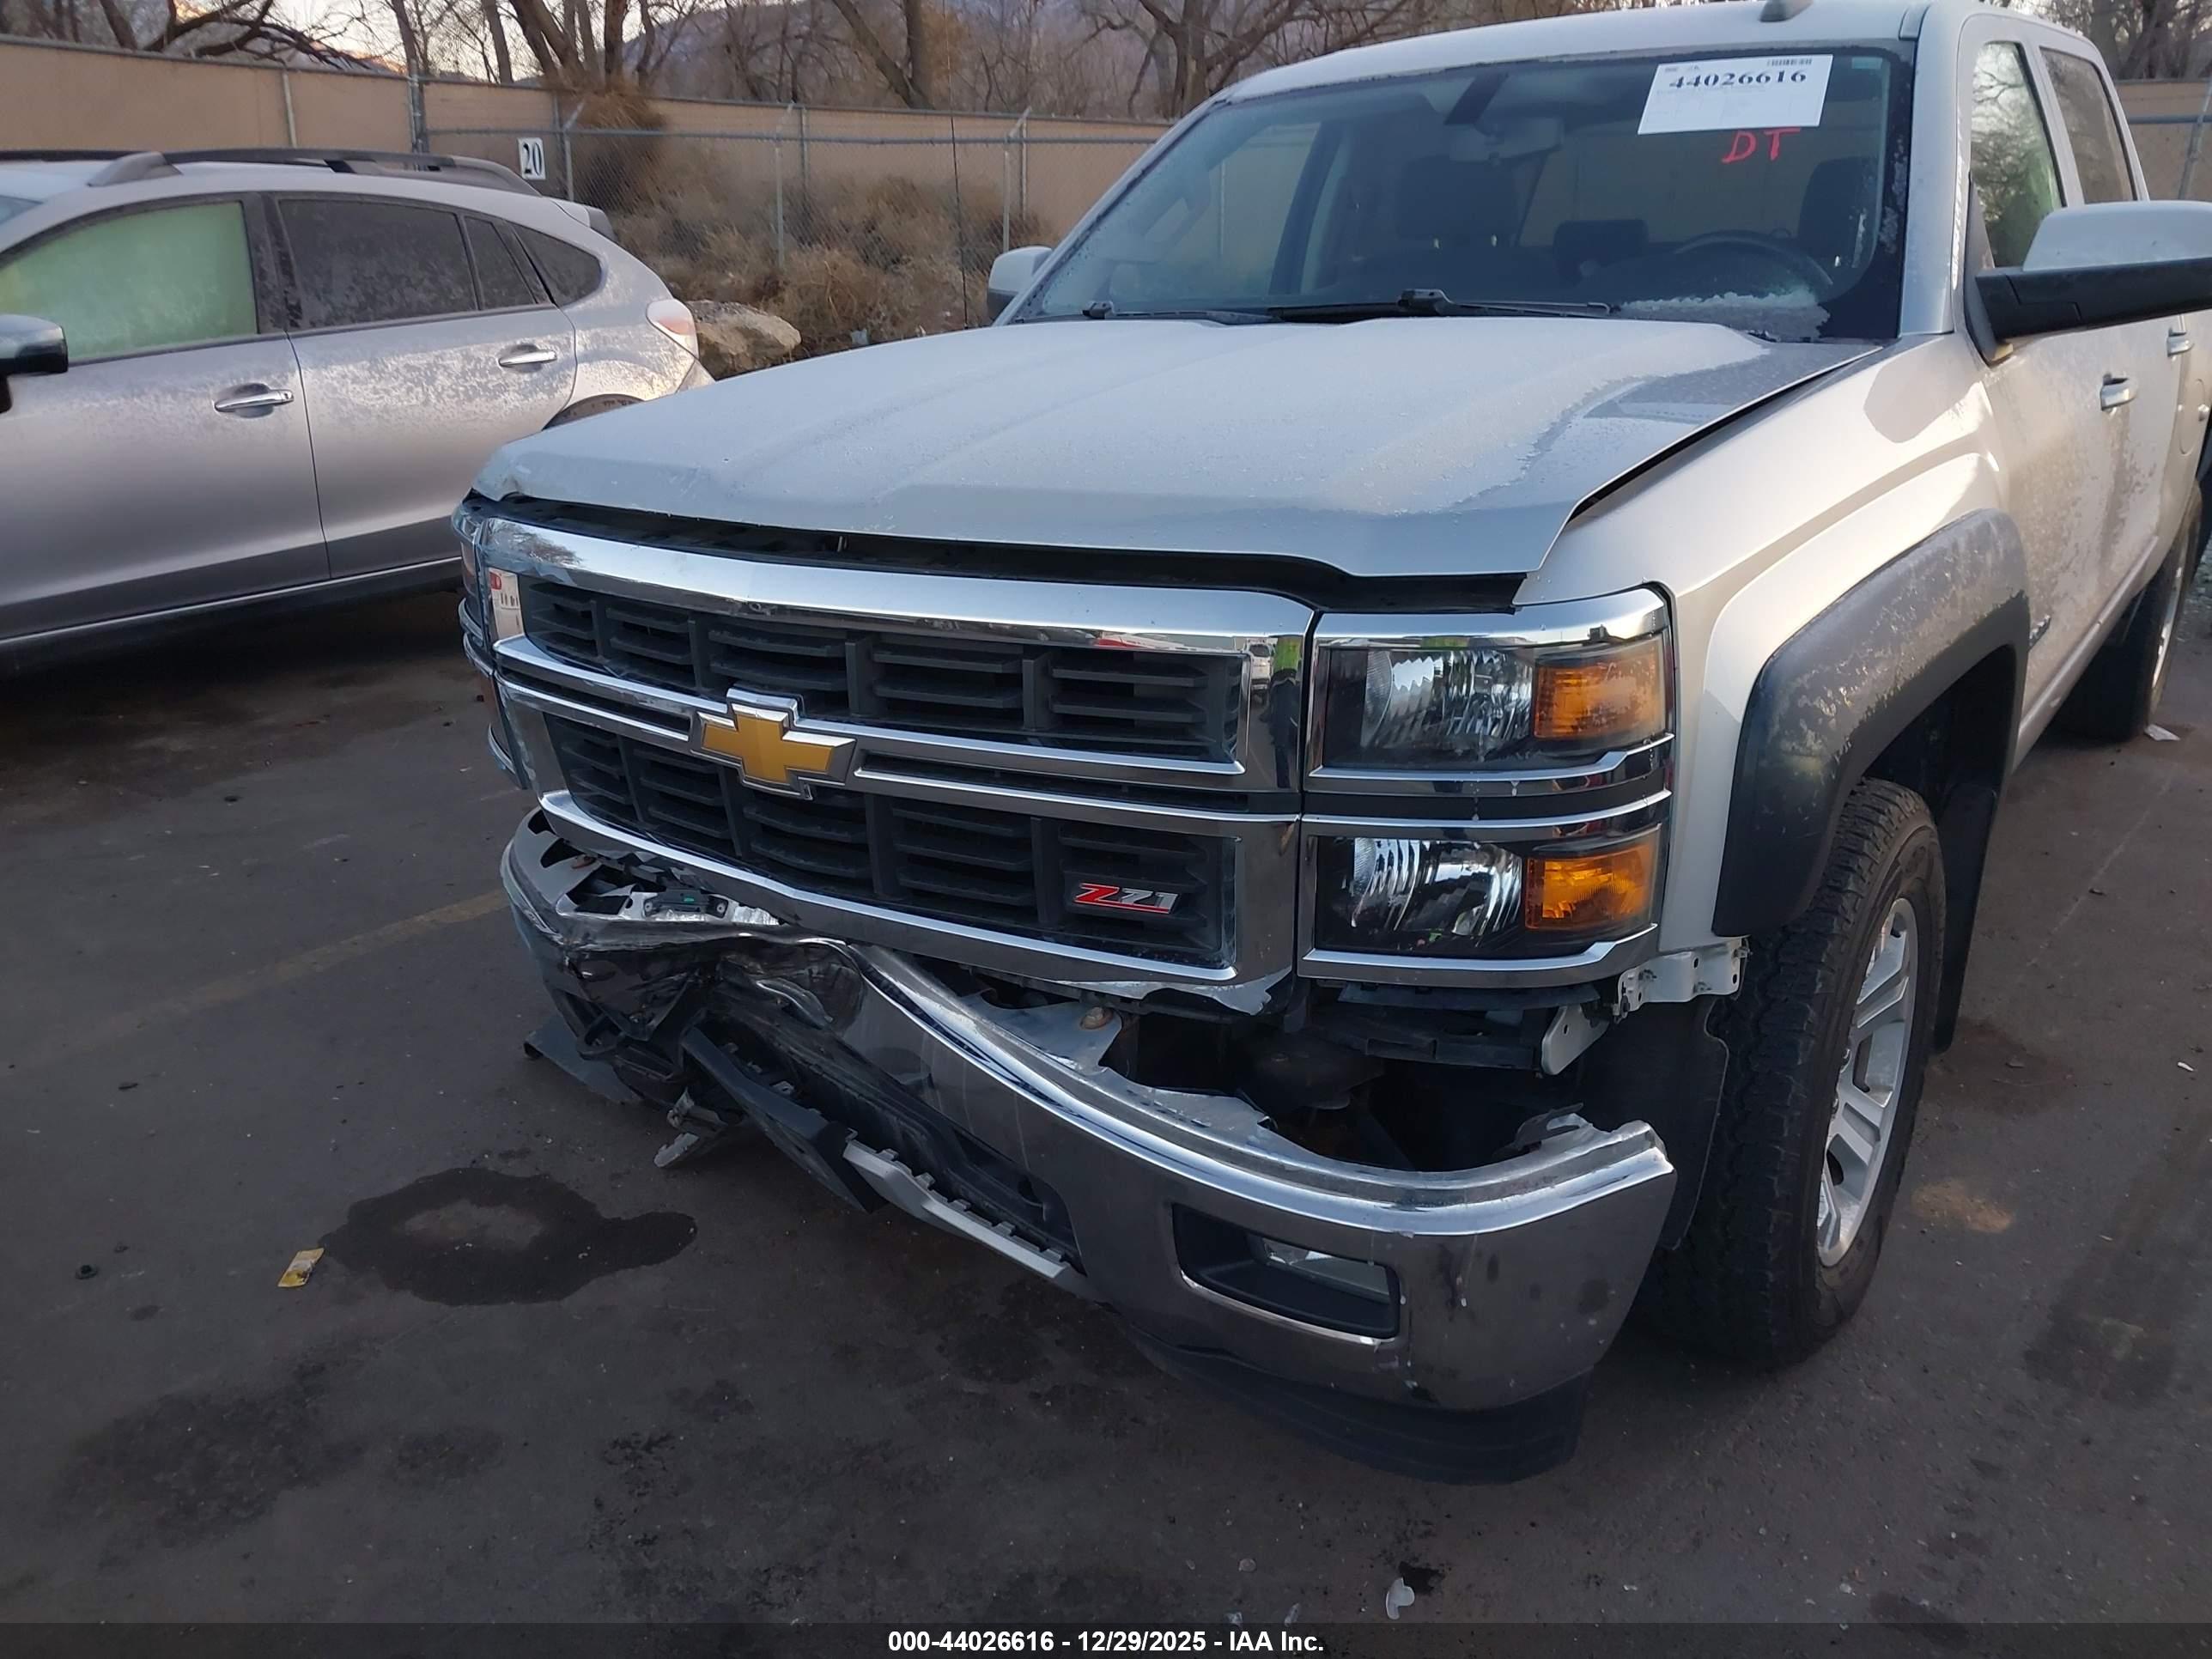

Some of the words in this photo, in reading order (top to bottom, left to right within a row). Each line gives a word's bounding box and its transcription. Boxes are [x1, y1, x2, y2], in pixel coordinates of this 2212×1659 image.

[1668, 70, 1807, 88] 44026616
[522, 142, 543, 176] 20
[1721, 126, 1802, 163] DT
[1073, 882, 1178, 914] Z71
